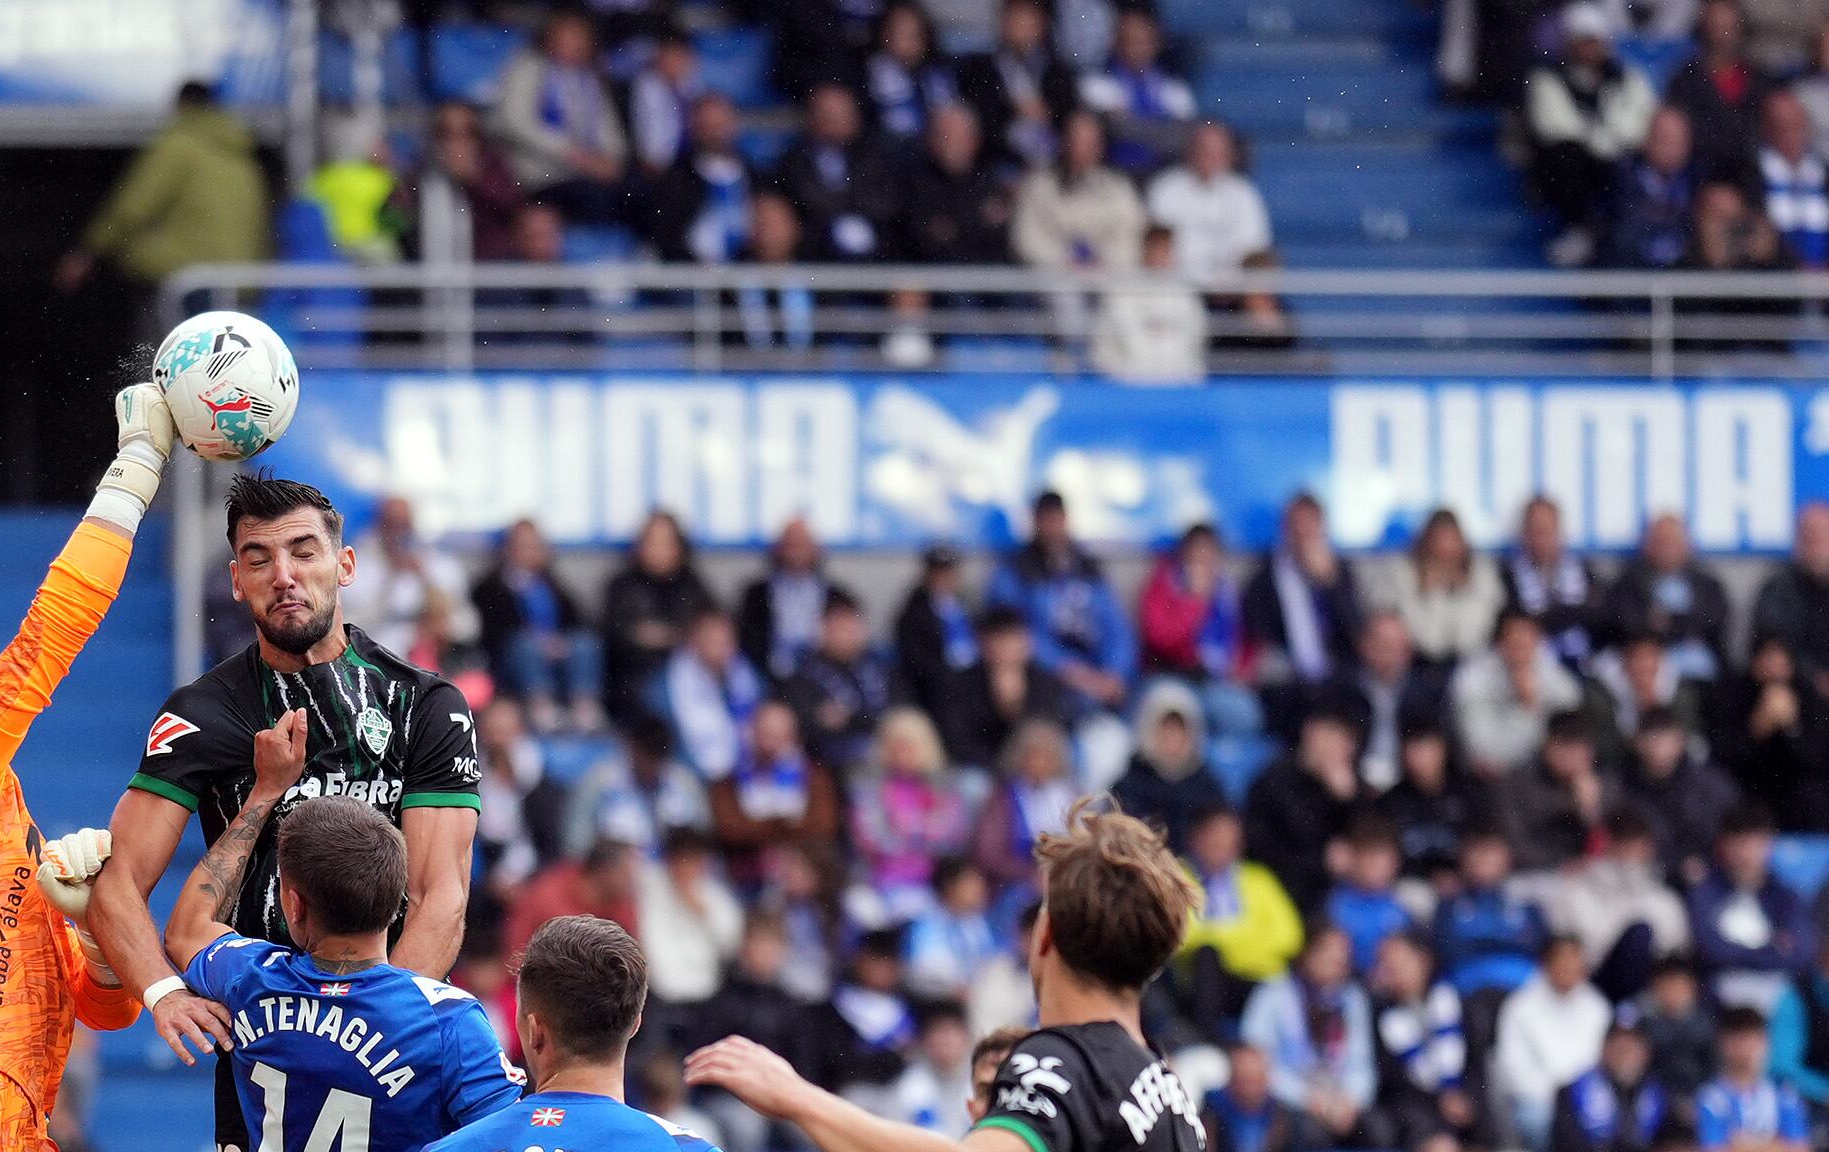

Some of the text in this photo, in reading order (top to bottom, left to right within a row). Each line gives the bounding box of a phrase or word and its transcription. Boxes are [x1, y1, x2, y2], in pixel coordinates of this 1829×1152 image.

[1329, 380, 1795, 548] PUMA
[0, 865, 31, 929] álava
[234, 996, 416, 1098] N.TENAGLIA
